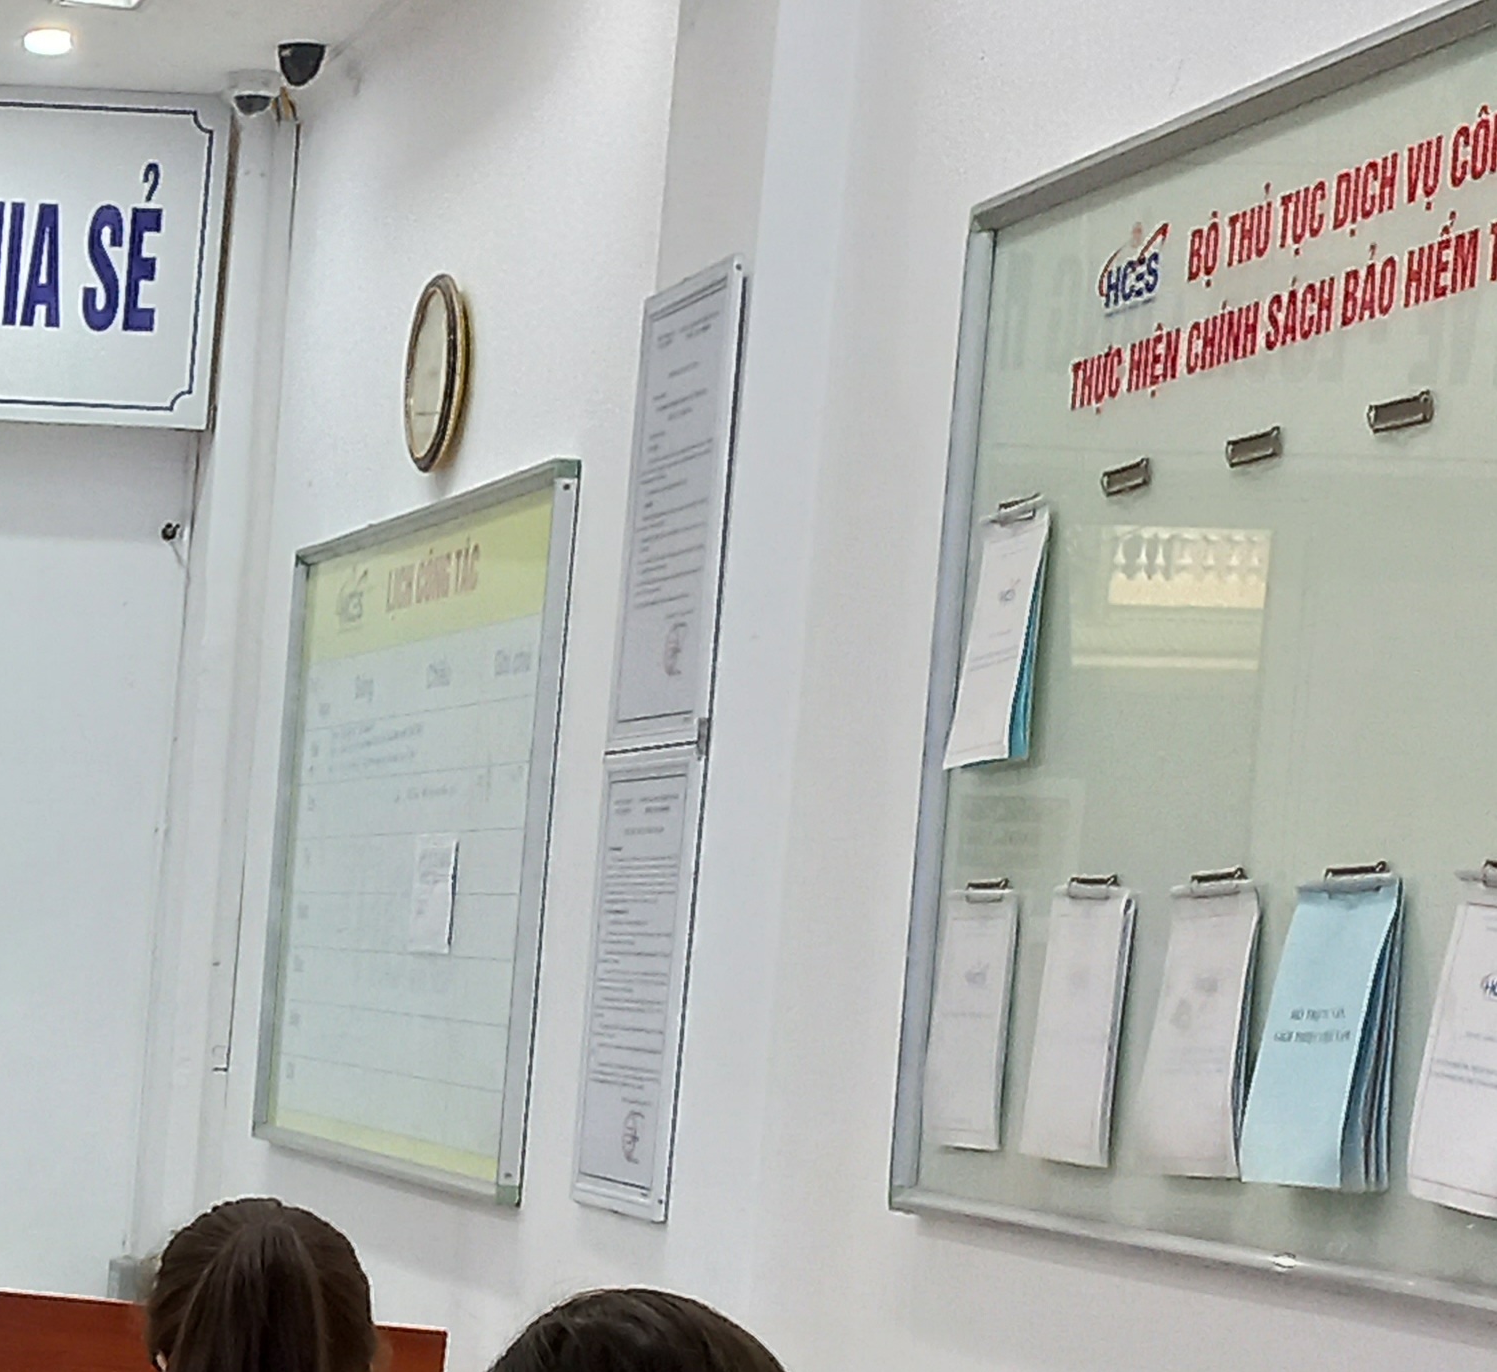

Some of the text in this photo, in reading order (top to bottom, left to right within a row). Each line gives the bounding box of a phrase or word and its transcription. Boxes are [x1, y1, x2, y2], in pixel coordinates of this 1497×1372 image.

[82, 162, 162, 332] SẺ
[1188, 105, 1497, 287] BỘ THỦ TỤC DỊCH VỤ CÔ
[1070, 344, 1122, 414] THỰC
[1126, 323, 1181, 397] HIỆN
[1186, 300, 1260, 375] CHÍNH
[1264, 277, 1335, 351] SÁCH
[1340, 243, 1396, 328] BẢO
[1403, 211, 1481, 307] HIỂM
